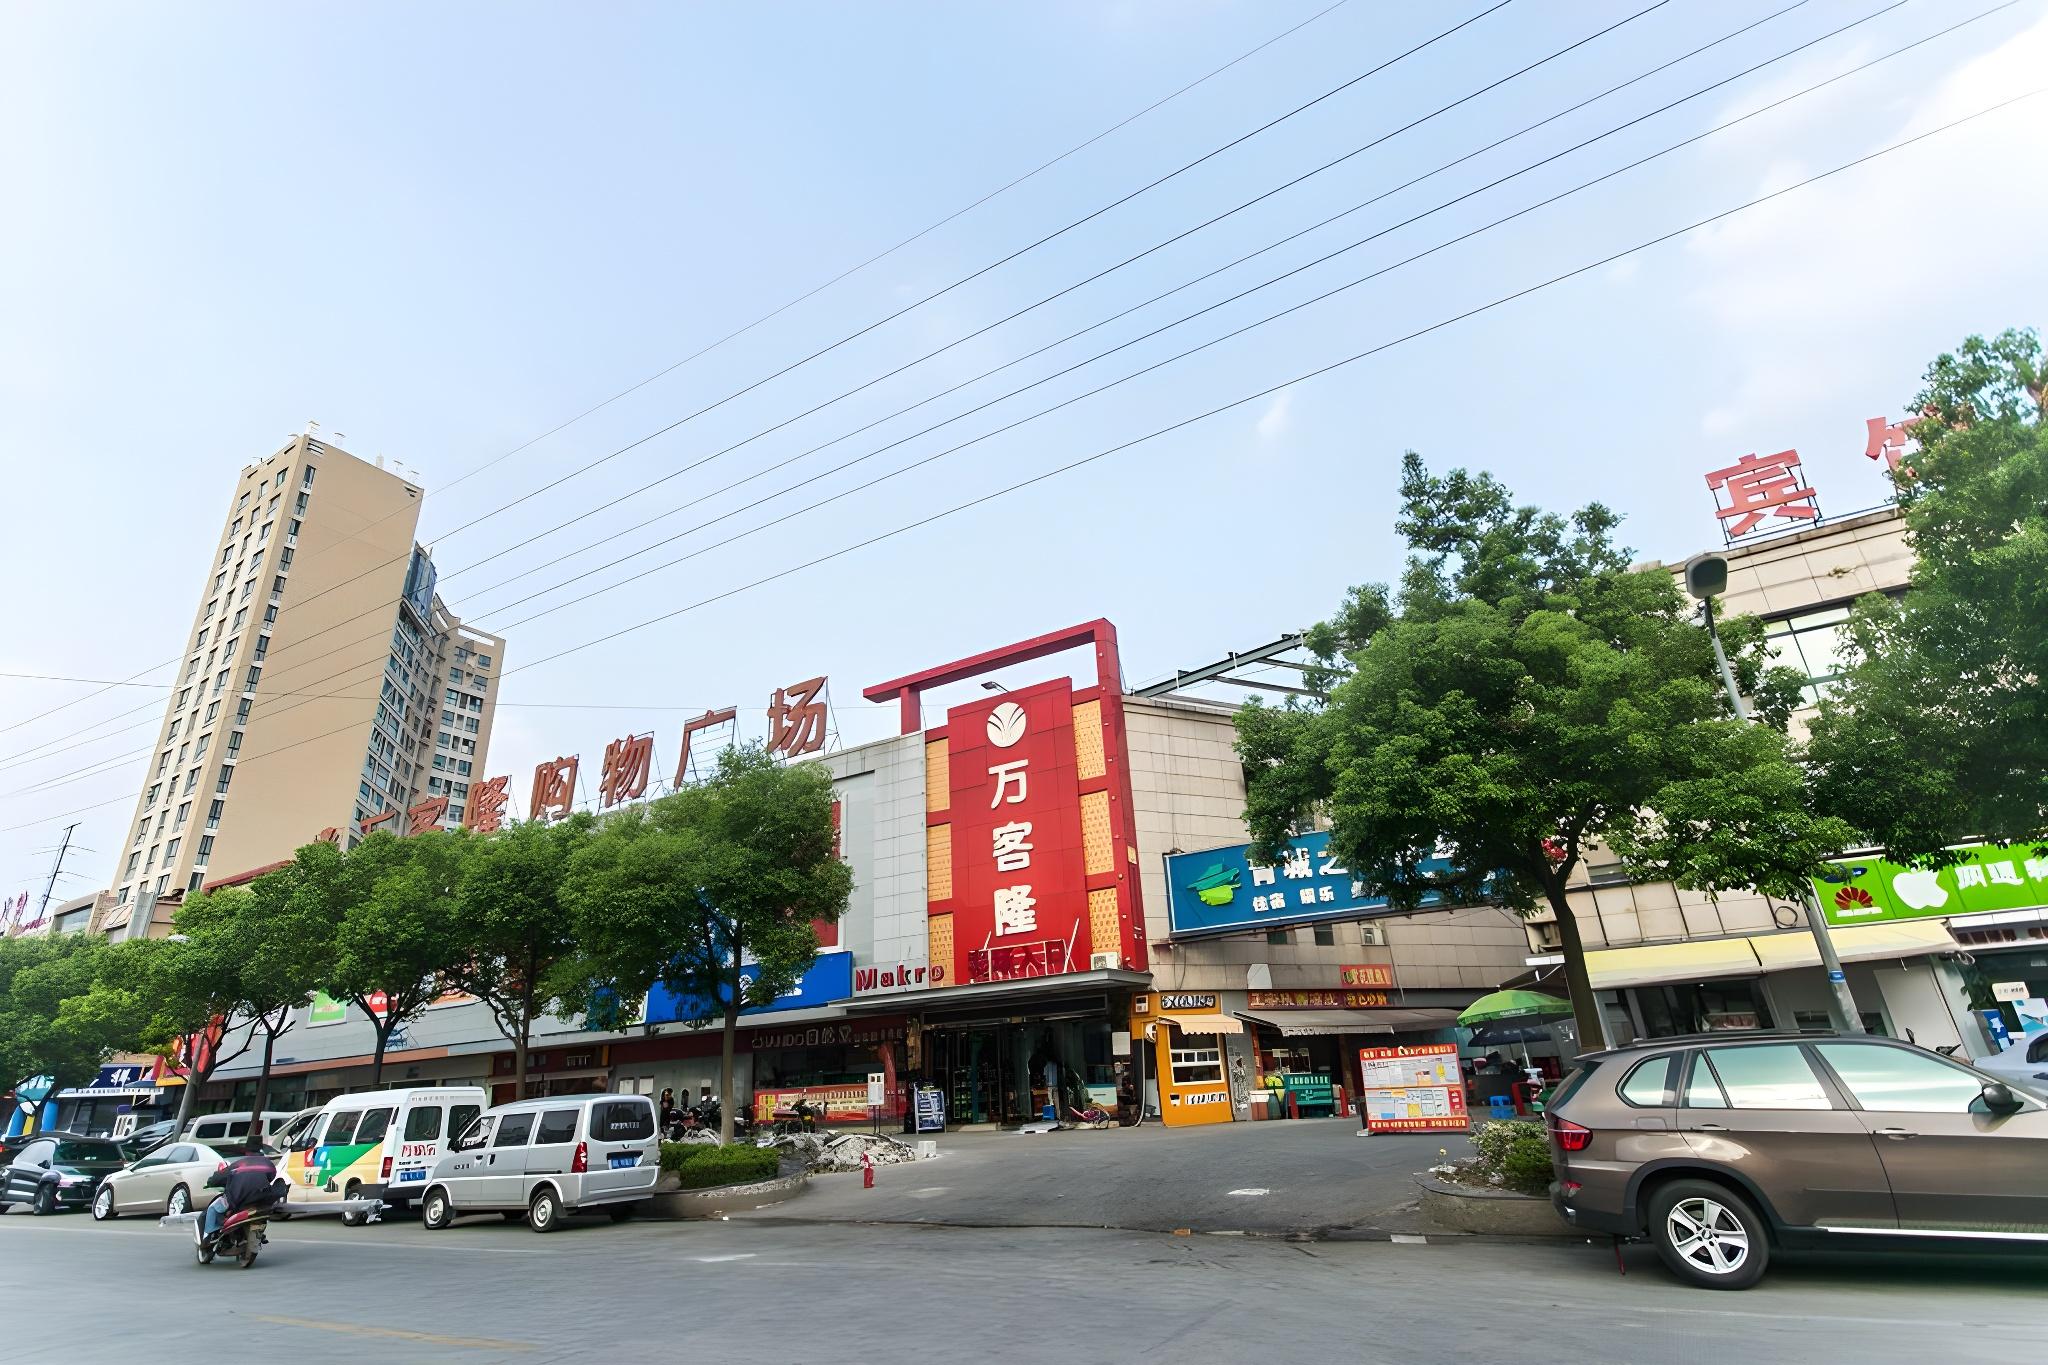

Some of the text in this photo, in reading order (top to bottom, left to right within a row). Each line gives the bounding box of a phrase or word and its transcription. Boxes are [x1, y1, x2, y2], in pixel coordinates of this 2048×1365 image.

[988, 758, 1038, 937] 万客隆
[855, 964, 945, 992] Makro
